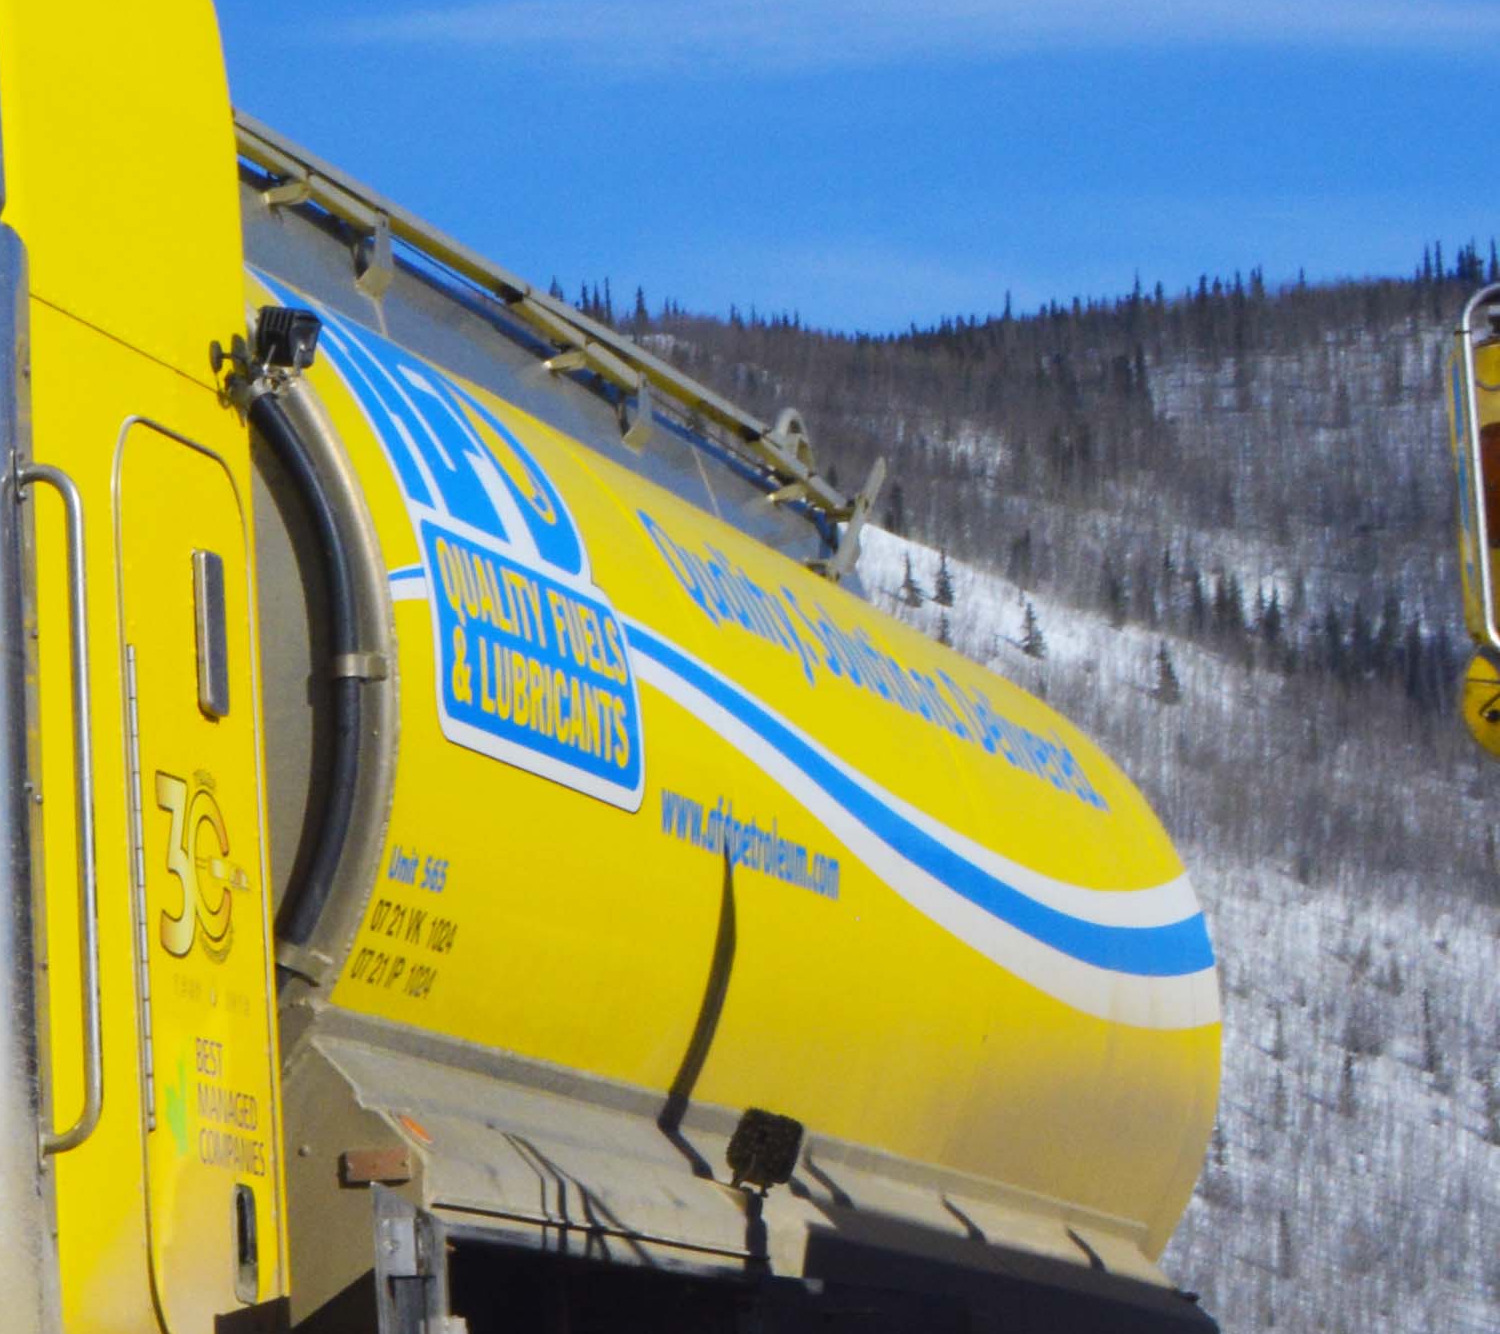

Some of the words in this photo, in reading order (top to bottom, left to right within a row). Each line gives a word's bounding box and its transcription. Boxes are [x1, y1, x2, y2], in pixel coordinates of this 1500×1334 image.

[436, 537, 547, 649] QUALITY
[546, 588, 627, 686] FUELS
[453, 625, 472, 705] &
[478, 635, 629, 768] LUBRICANTS
[420, 855, 449, 894] 565
[196, 1037, 223, 1079] BEST
[198, 1082, 258, 1132] MANAGED
[200, 1127, 266, 1177] COMPANIES
